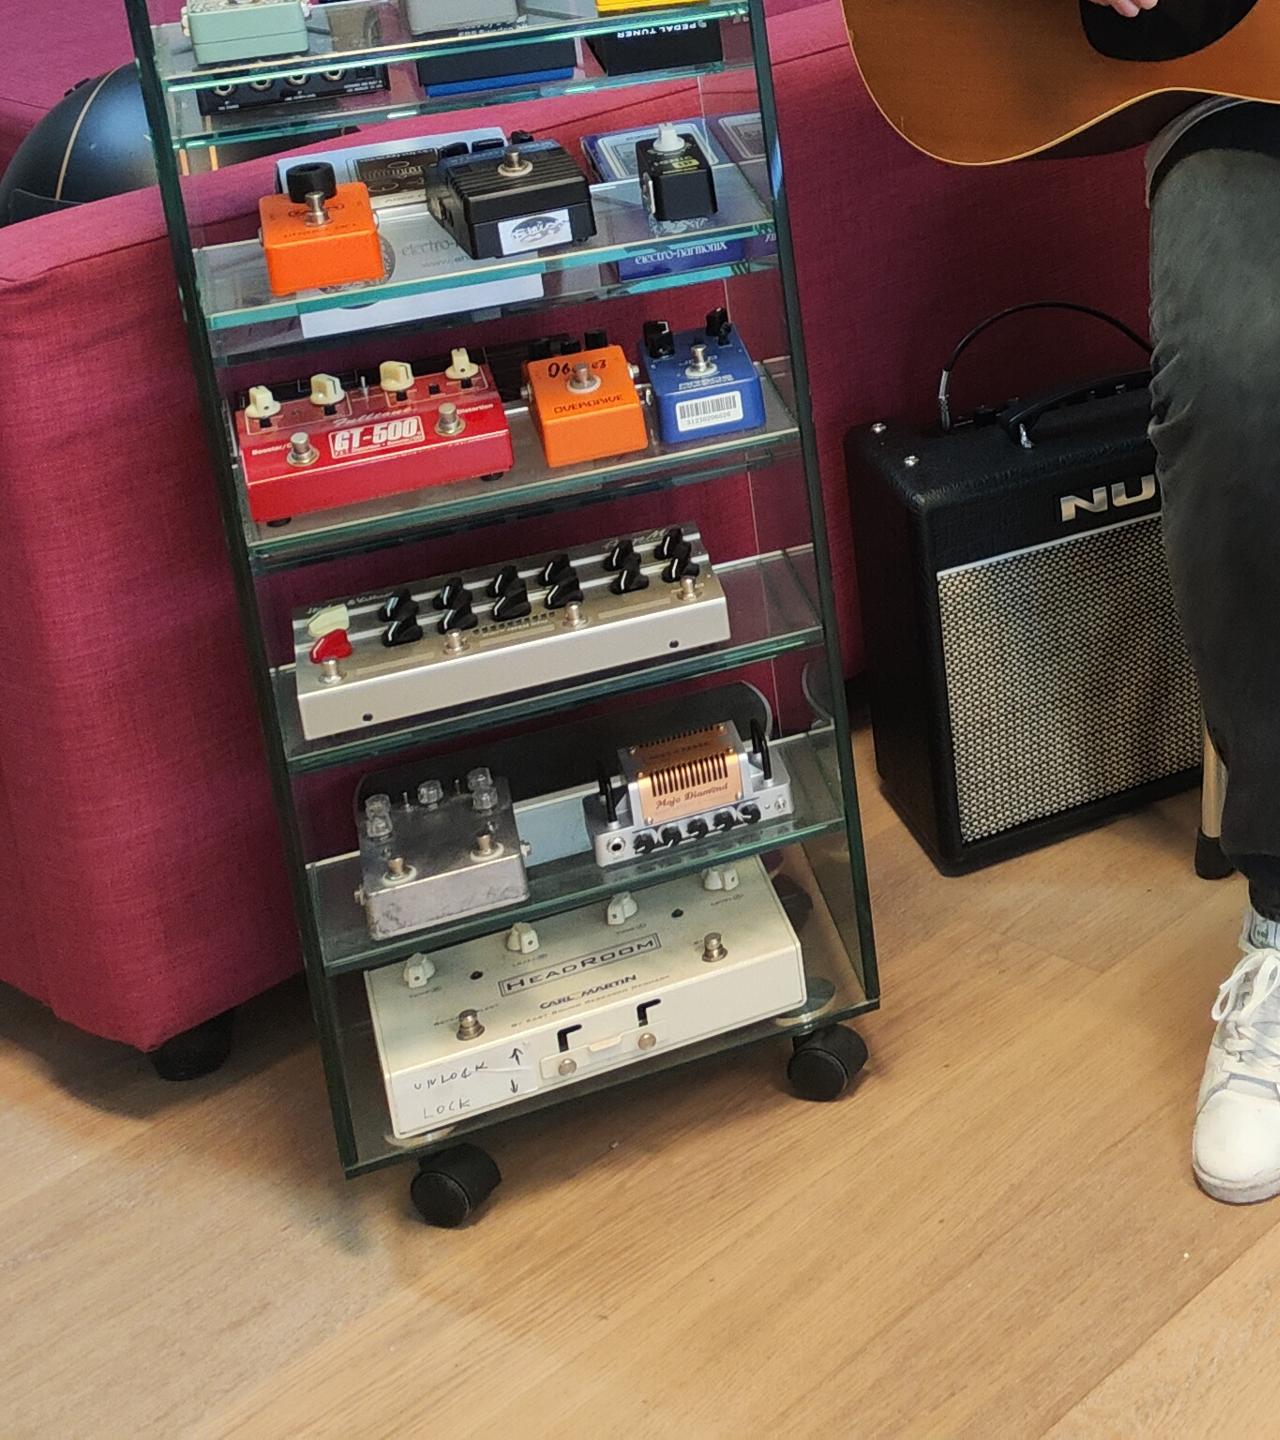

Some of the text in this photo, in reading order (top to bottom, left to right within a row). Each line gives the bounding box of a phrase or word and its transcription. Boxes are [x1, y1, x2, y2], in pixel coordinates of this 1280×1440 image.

[617, 22, 697, 39] PEDAL TUNER
[334, 418, 419, 451] GT-500
[1060, 473, 1156, 523] NU
[656, 783, 729, 810] Mojo Diamond
[539, 974, 637, 1009] CARL MARTIN
[423, 1097, 471, 1120] LOCK
